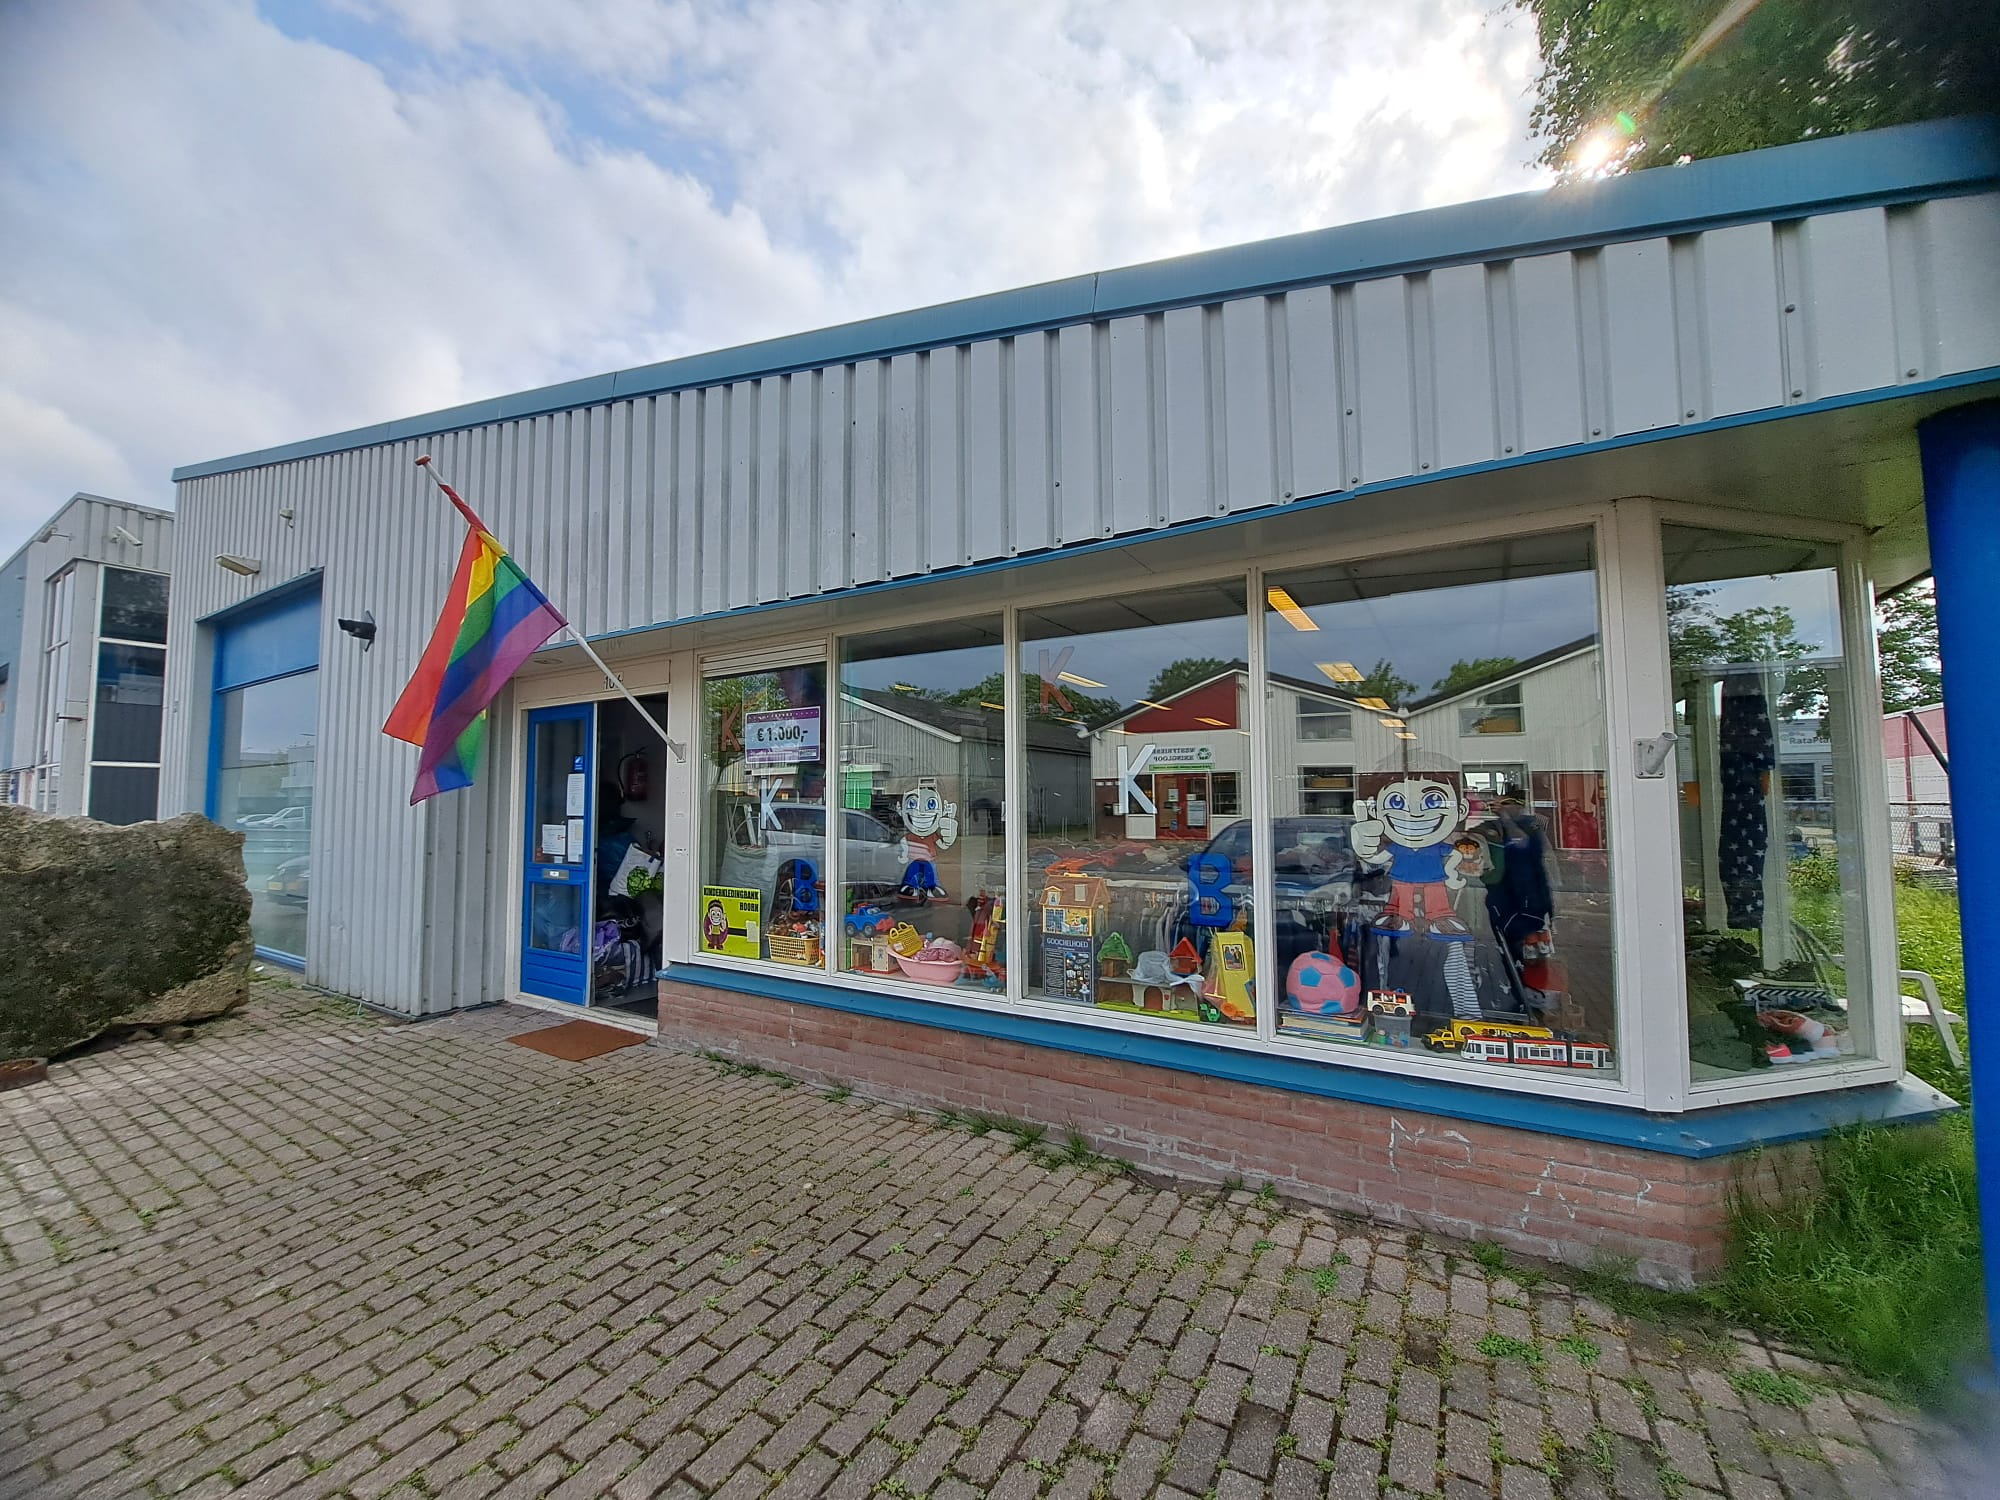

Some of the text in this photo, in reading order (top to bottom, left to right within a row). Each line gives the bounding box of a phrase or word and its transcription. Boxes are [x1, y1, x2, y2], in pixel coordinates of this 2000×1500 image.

[1038, 646, 1075, 714] K
[720, 704, 741, 752] K
[759, 777, 783, 831] K
[1117, 743, 1158, 815] K
[793, 857, 819, 911] B
[1188, 853, 1233, 928] B
